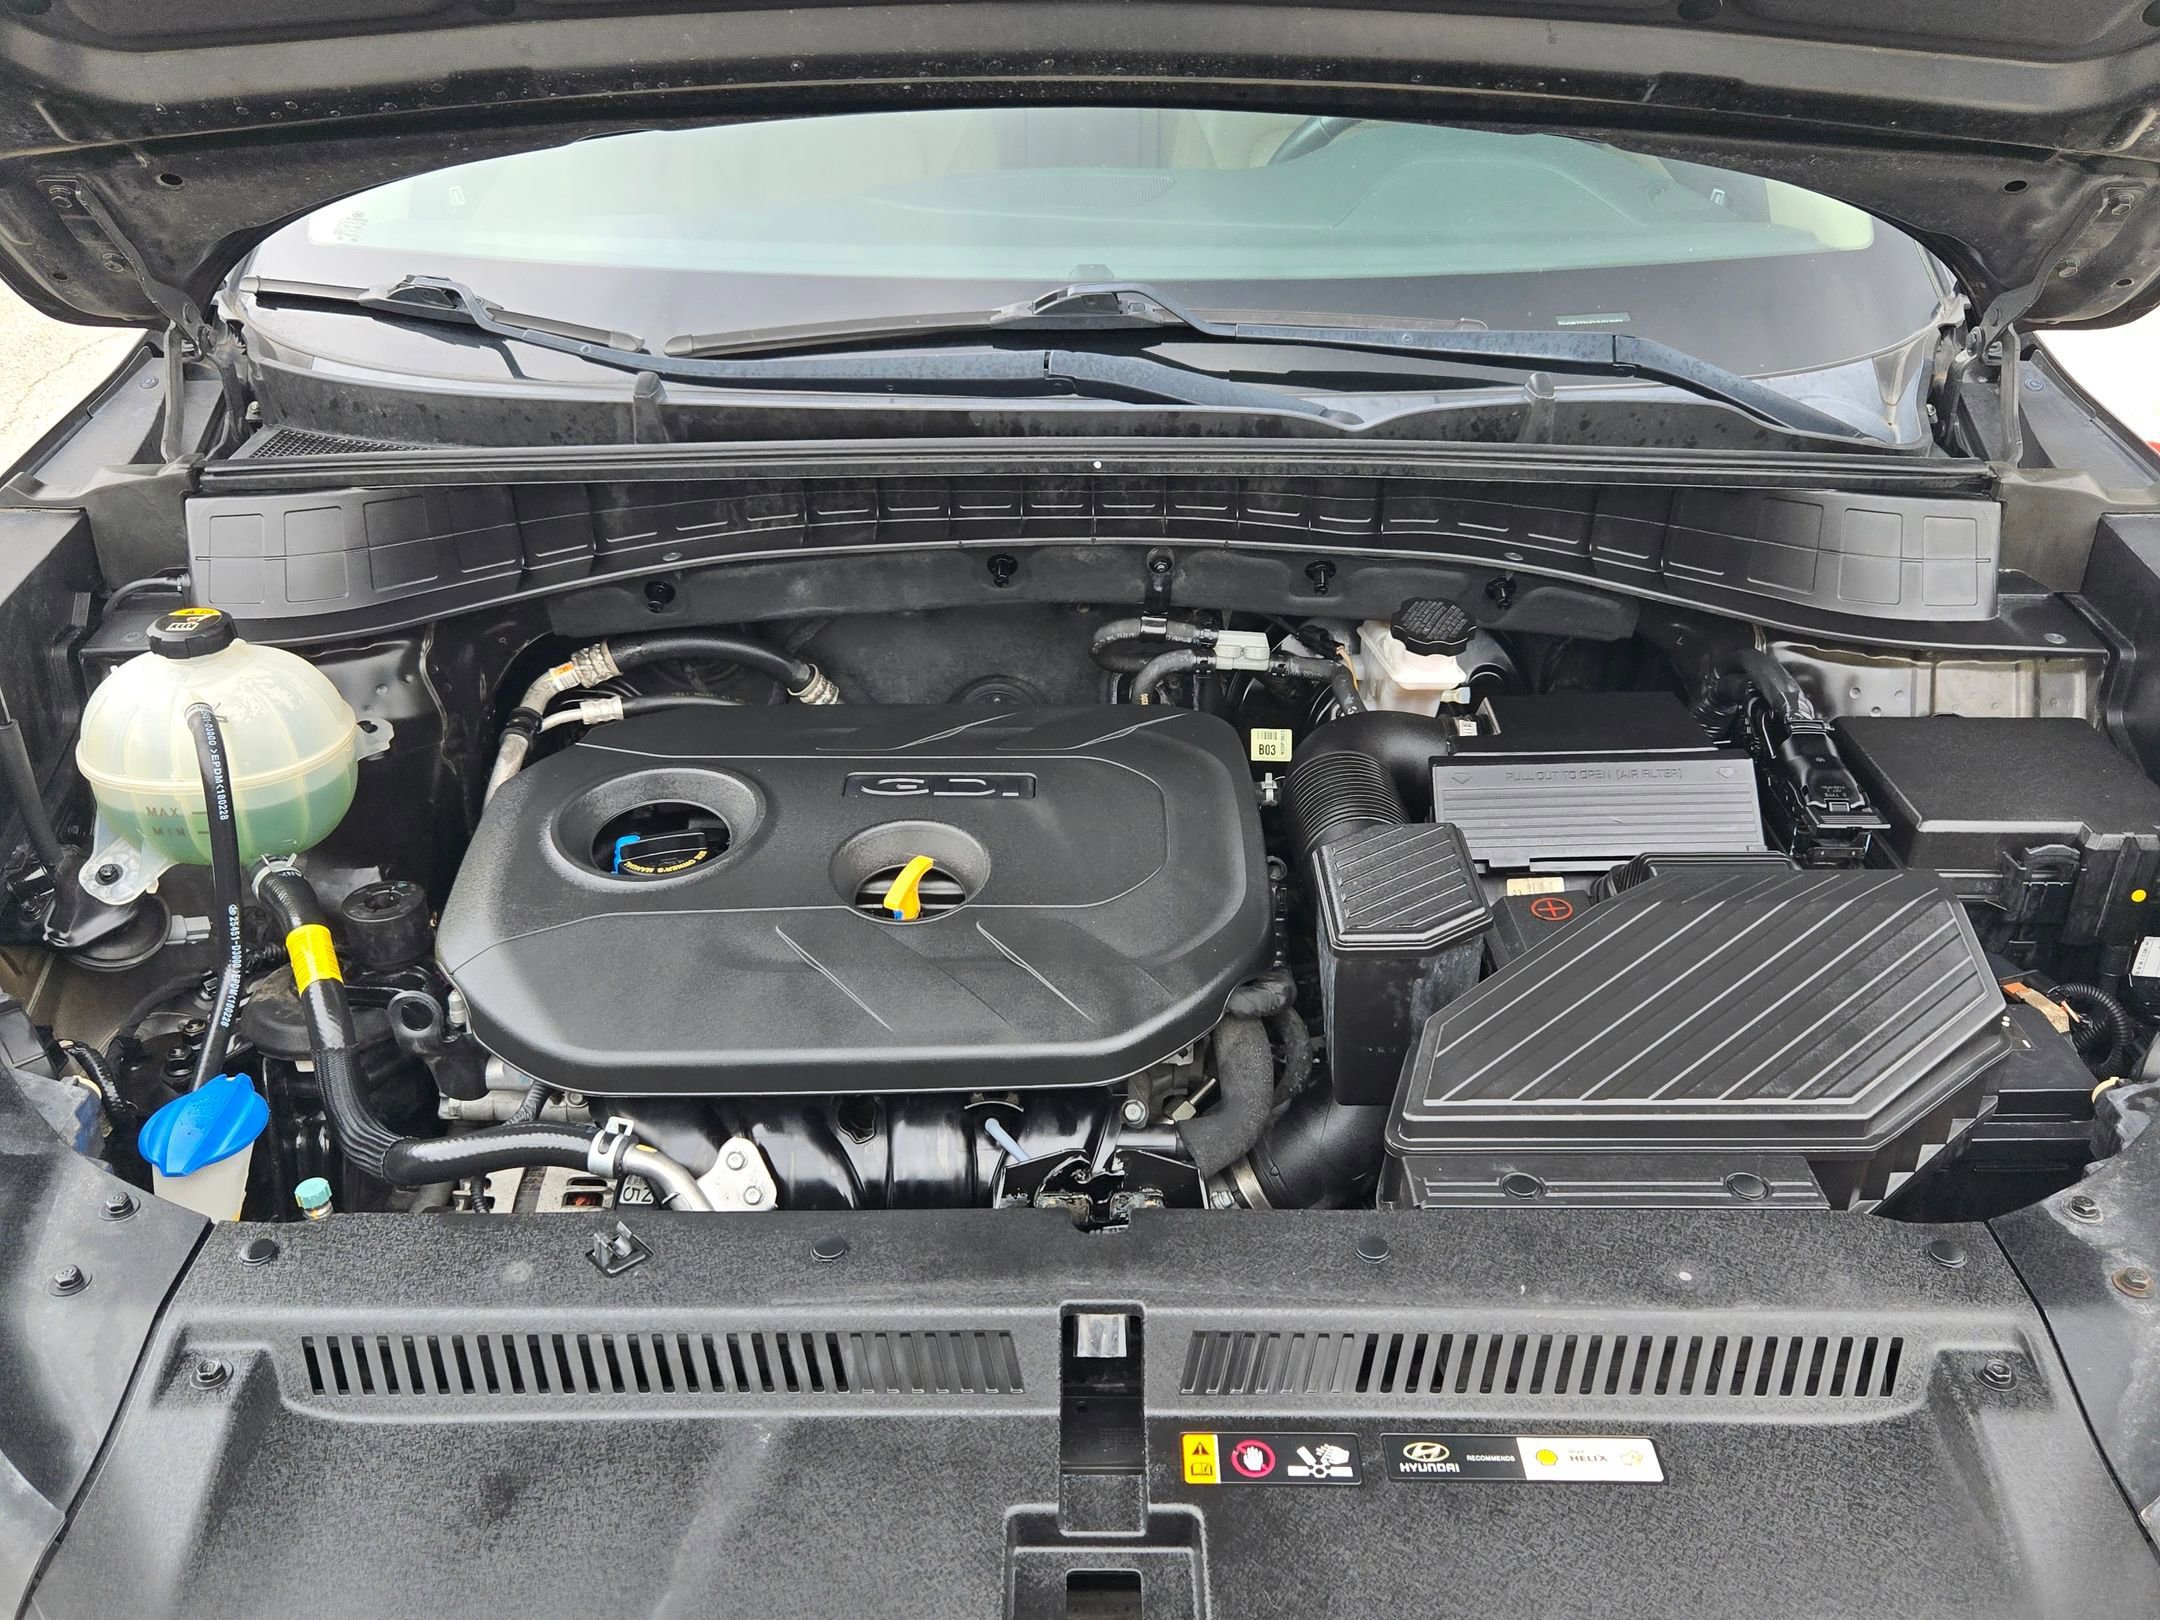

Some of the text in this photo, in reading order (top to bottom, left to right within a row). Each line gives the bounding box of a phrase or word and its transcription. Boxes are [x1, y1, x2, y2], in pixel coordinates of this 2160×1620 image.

[1258, 743, 1276, 756] B03
[1505, 771, 1534, 781] PULL
[1536, 770, 1559, 780] OUT
[1563, 770, 1577, 780] TO
[1579, 769, 1611, 780] OPEN
[146, 806, 180, 817] MAX
[152, 826, 186, 837] MIN
[1466, 1454, 1516, 1463] RECOMMENDS
[1399, 1461, 1460, 1473] HYUNDAI
